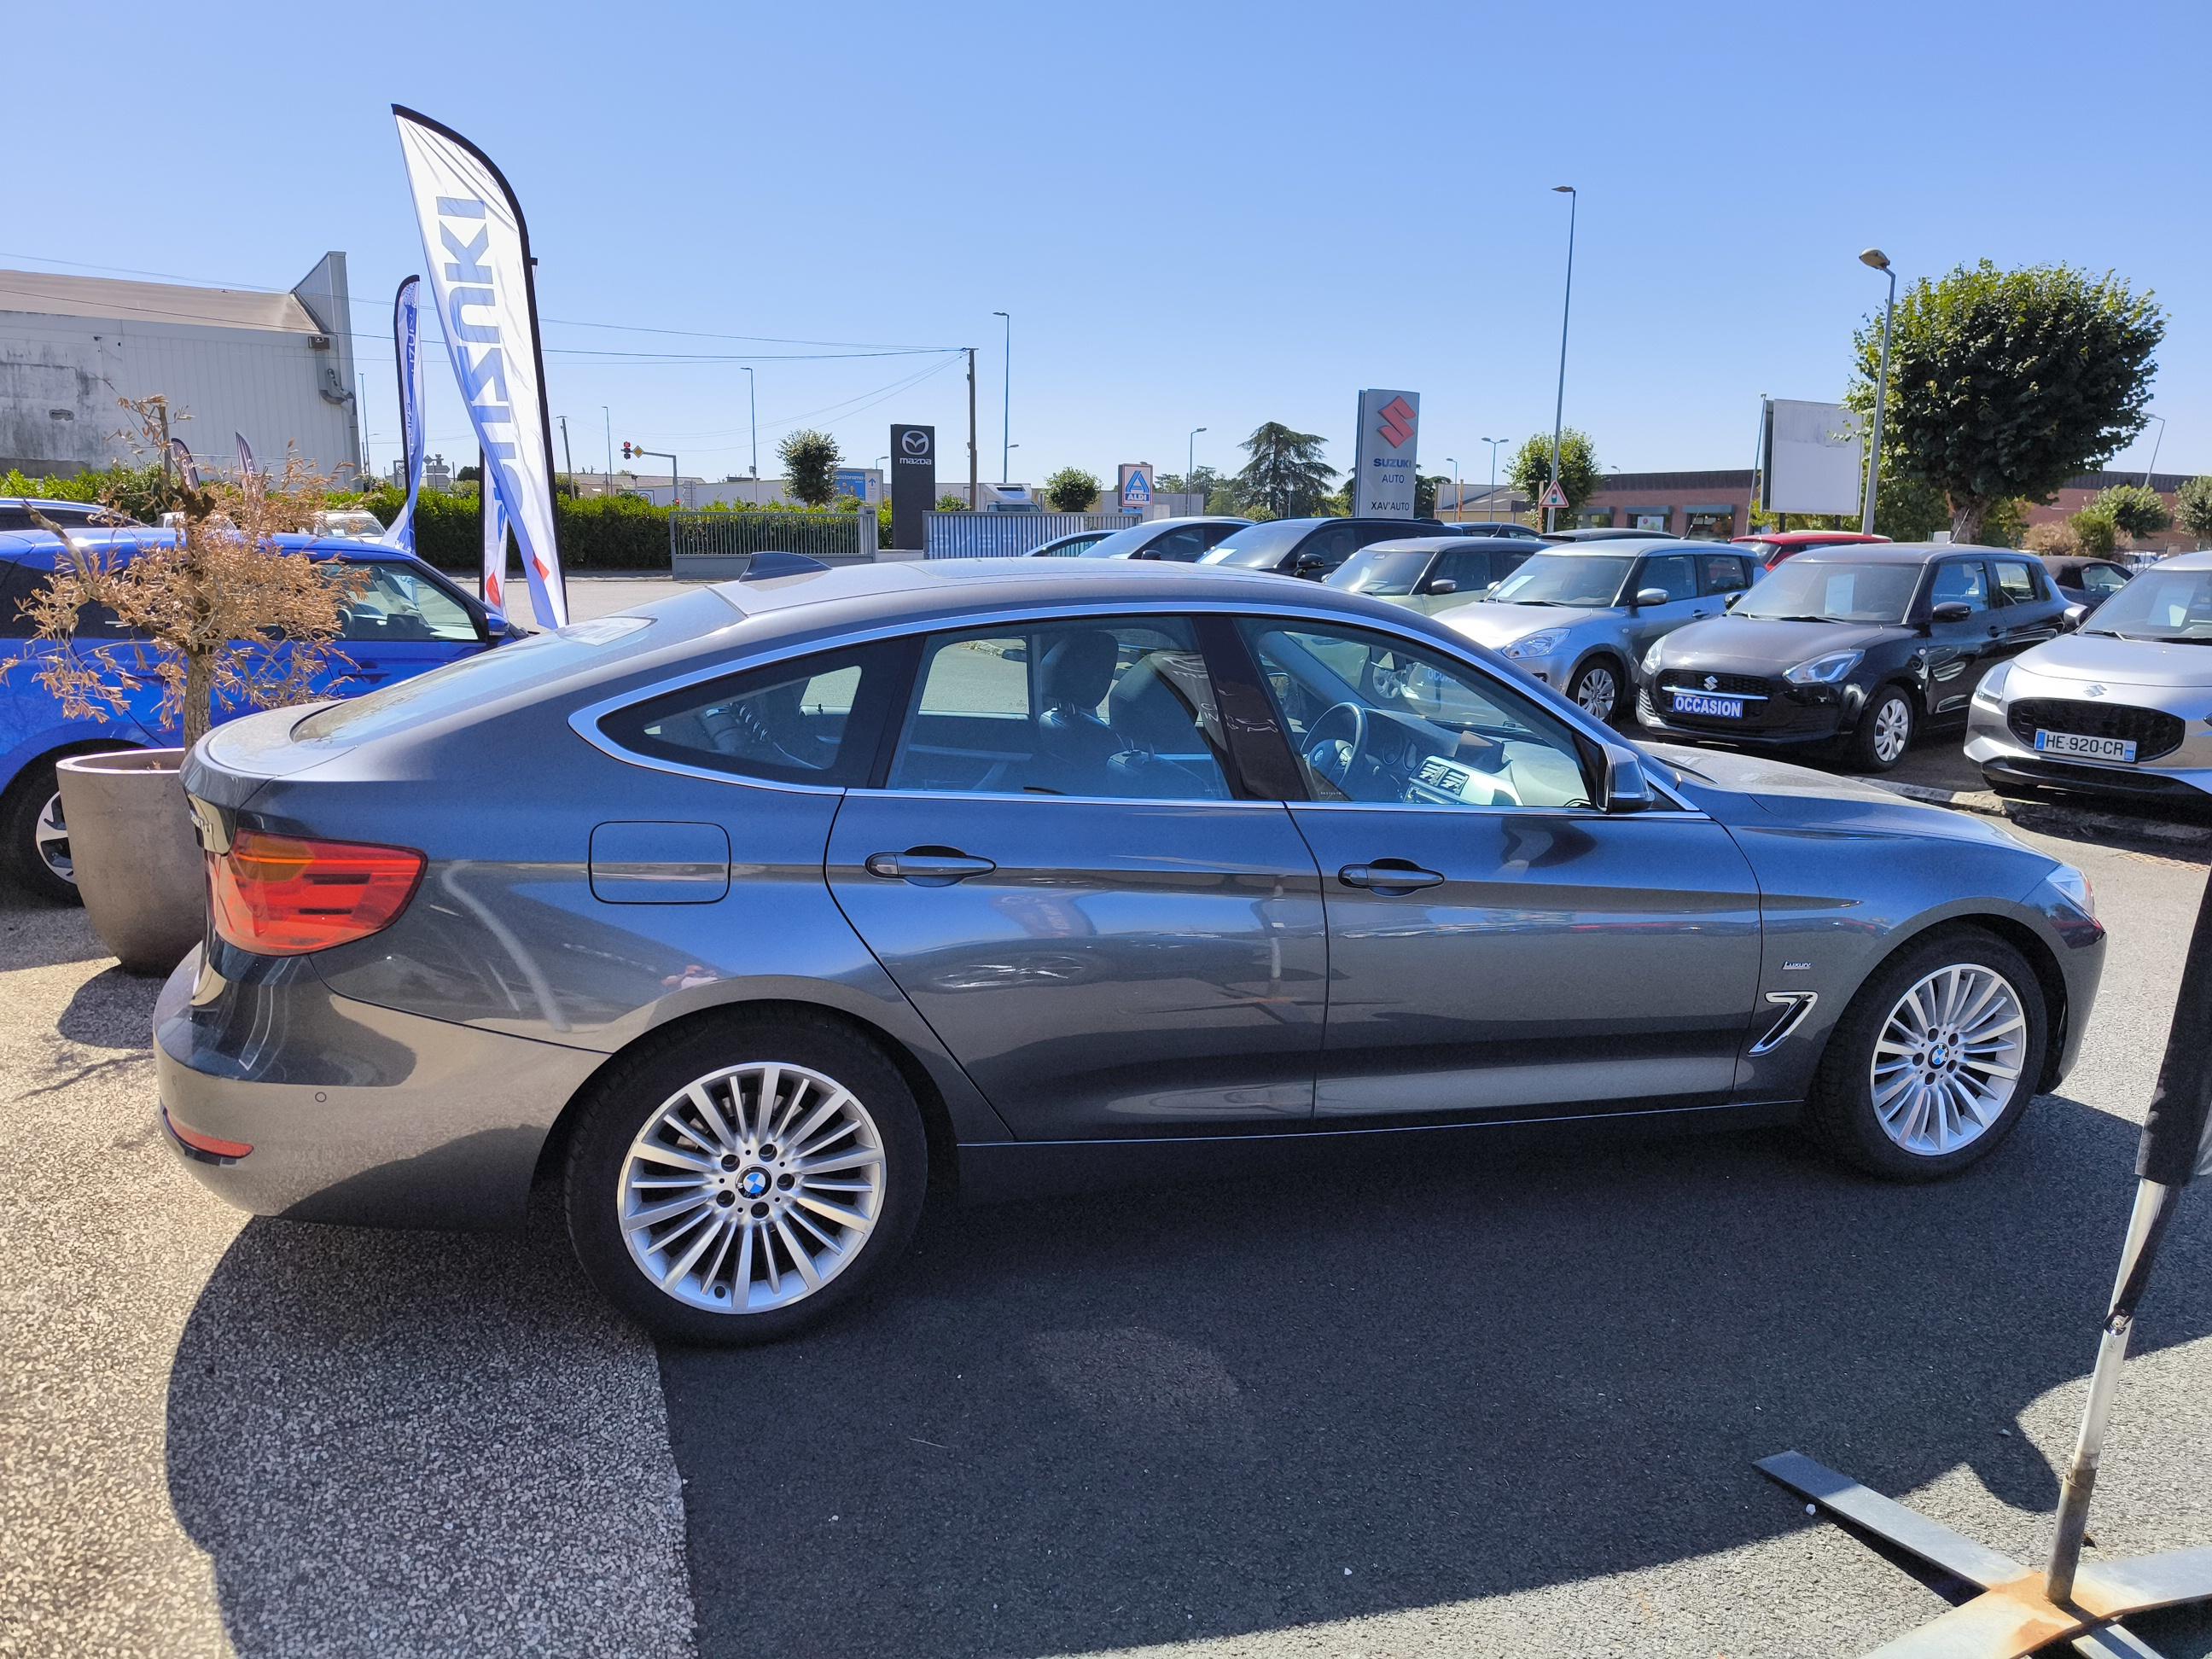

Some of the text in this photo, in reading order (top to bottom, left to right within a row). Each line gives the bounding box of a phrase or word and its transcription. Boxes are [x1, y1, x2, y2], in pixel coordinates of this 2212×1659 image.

[1373, 458, 1412, 469] SUZUKI
[1382, 474, 1405, 484] AUTO
[1675, 696, 1741, 718] OCCASION
[2046, 734, 2124, 756] HE-920-CR
